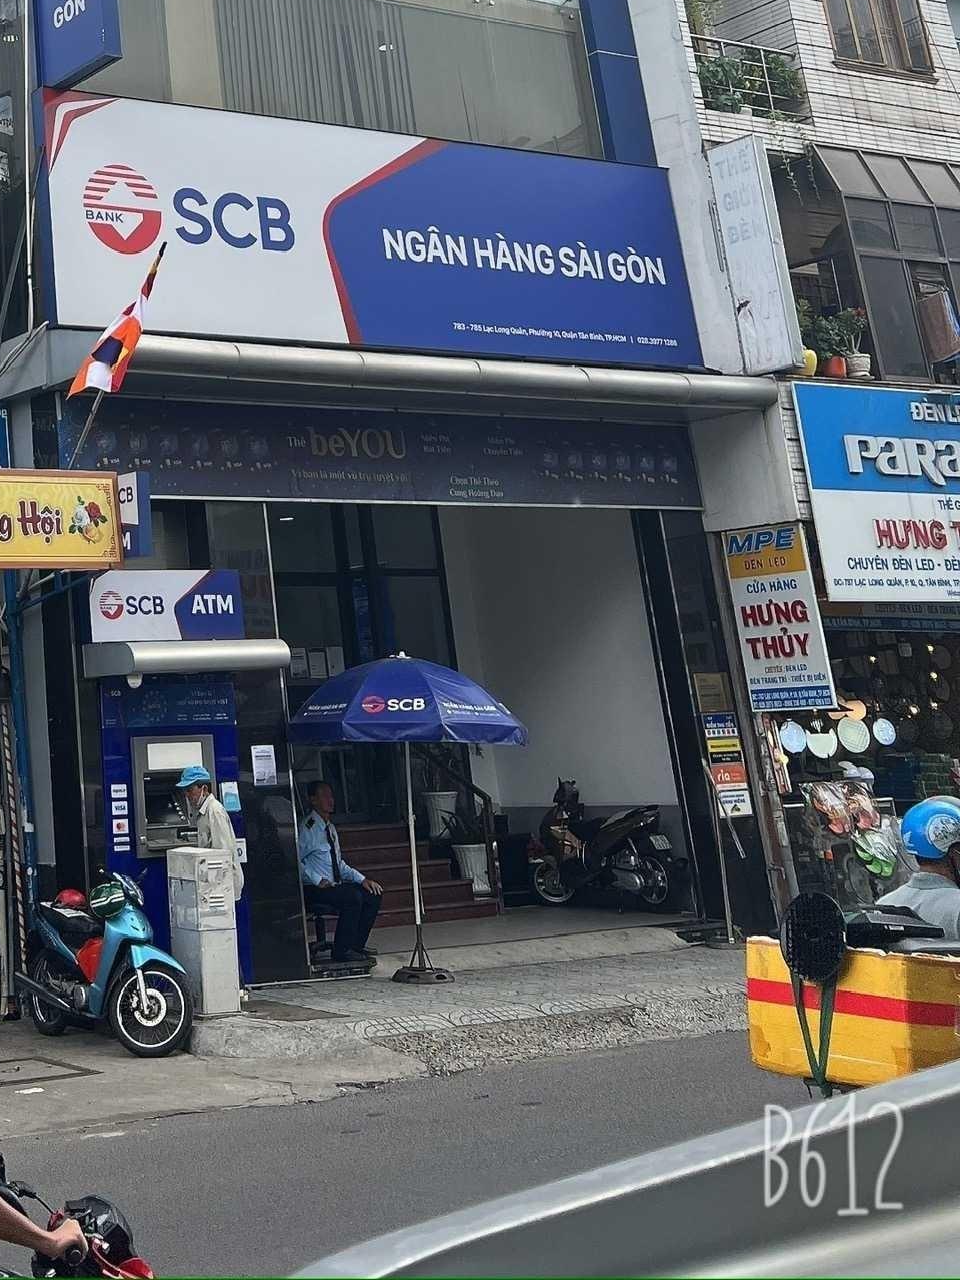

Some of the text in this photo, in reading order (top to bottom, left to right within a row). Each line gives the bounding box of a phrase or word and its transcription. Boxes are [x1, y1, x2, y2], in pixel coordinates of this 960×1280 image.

[85, 209, 124, 223] BANK
[173, 187, 295, 252] SCB
[382, 225, 667, 286] NGÂN HÀNG SÀI GÒN
[910, 397, 946, 422] ĐÈN
[305, 426, 407, 459] beYOU
[117, 486, 134, 504] CB
[17, 500, 63, 543] Hội
[727, 527, 794, 556] MPE
[874, 519, 947, 550] HƯNG
[769, 556, 786, 568] LED
[847, 554, 889, 570] CHUYÊN
[892, 555, 913, 571] ĐÈN
[915, 558, 935, 571] LED
[746, 577, 797, 594] CỬA HÀNG
[126, 595, 164, 615] SCB
[192, 594, 234, 615] ATM
[740, 599, 810, 628] HƯNG
[745, 626, 809, 660] THỦY
[387, 698, 426, 711] SCB
